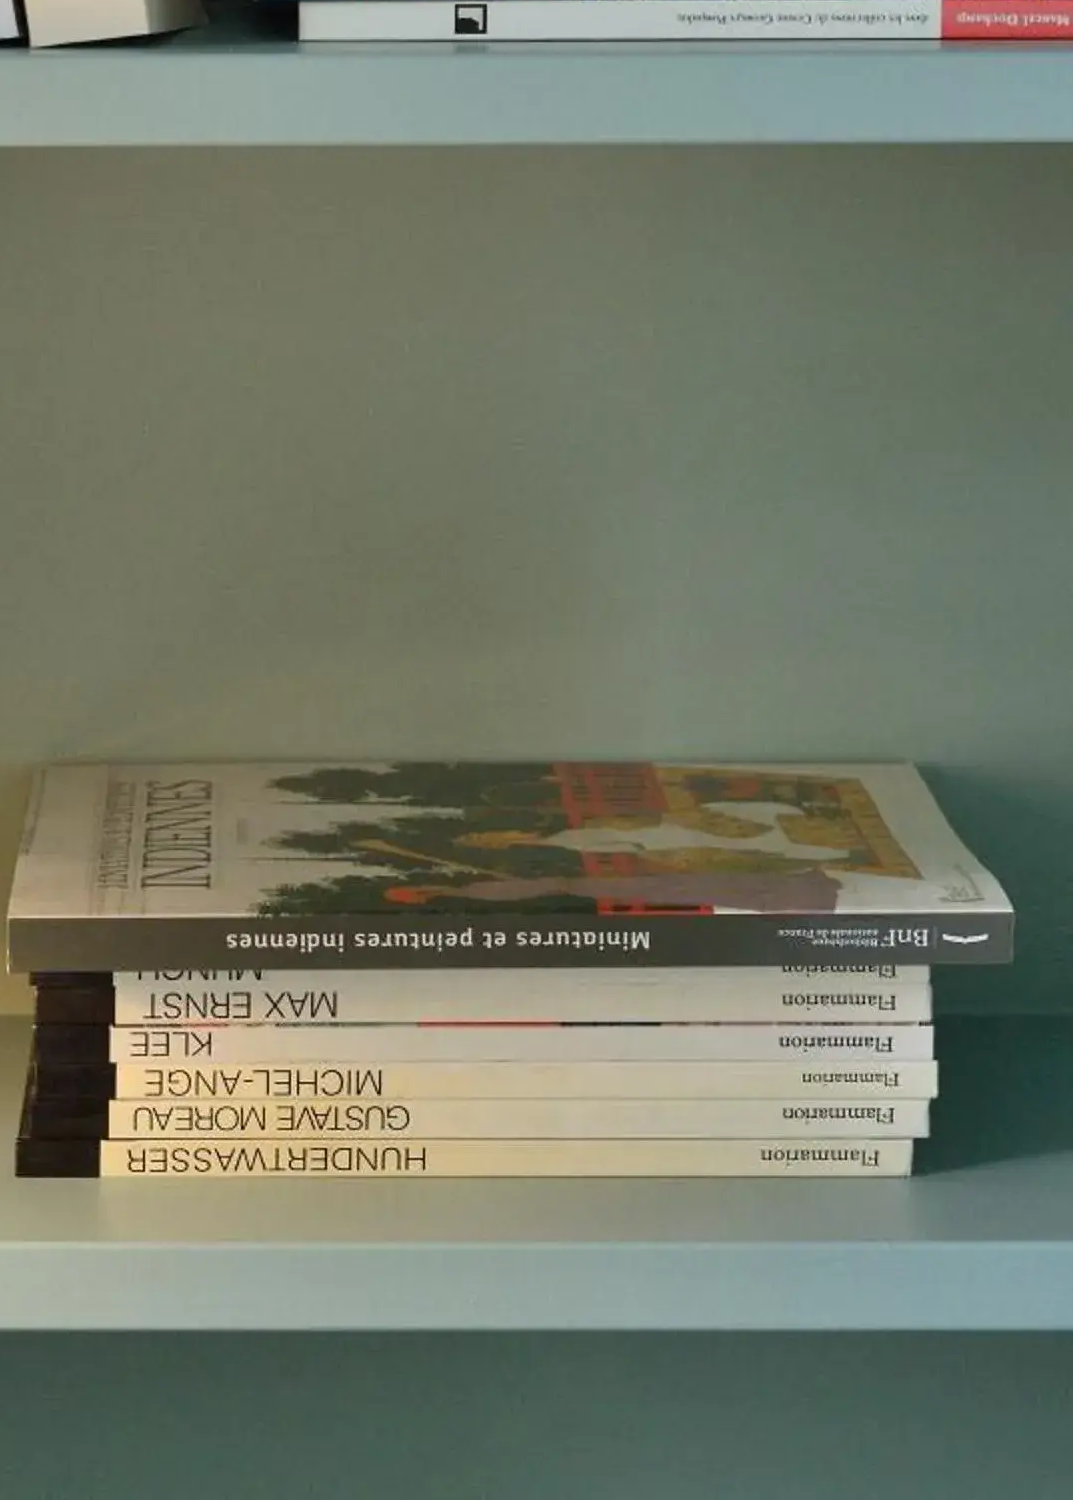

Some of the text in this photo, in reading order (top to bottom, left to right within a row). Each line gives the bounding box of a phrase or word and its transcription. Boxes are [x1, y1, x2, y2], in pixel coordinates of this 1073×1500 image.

[226, 928, 651, 951] Miniatures et peintures indiennes
[882, 929, 928, 947] BnF
[143, 991, 338, 1019] MAX ERNST
[782, 994, 896, 1011] Flammarion
[130, 1031, 212, 1057] KLEE
[779, 1036, 893, 1052] Flammarion
[144, 1069, 382, 1097] MICHEL-ANGE
[802, 1072, 900, 1086] Flammarion
[133, 1105, 410, 1131] GUSTAVE MOREAU
[782, 1107, 895, 1124] Flammarion
[127, 1147, 427, 1173] HUNDERTWASSER
[761, 1148, 880, 1167] Flammarion
